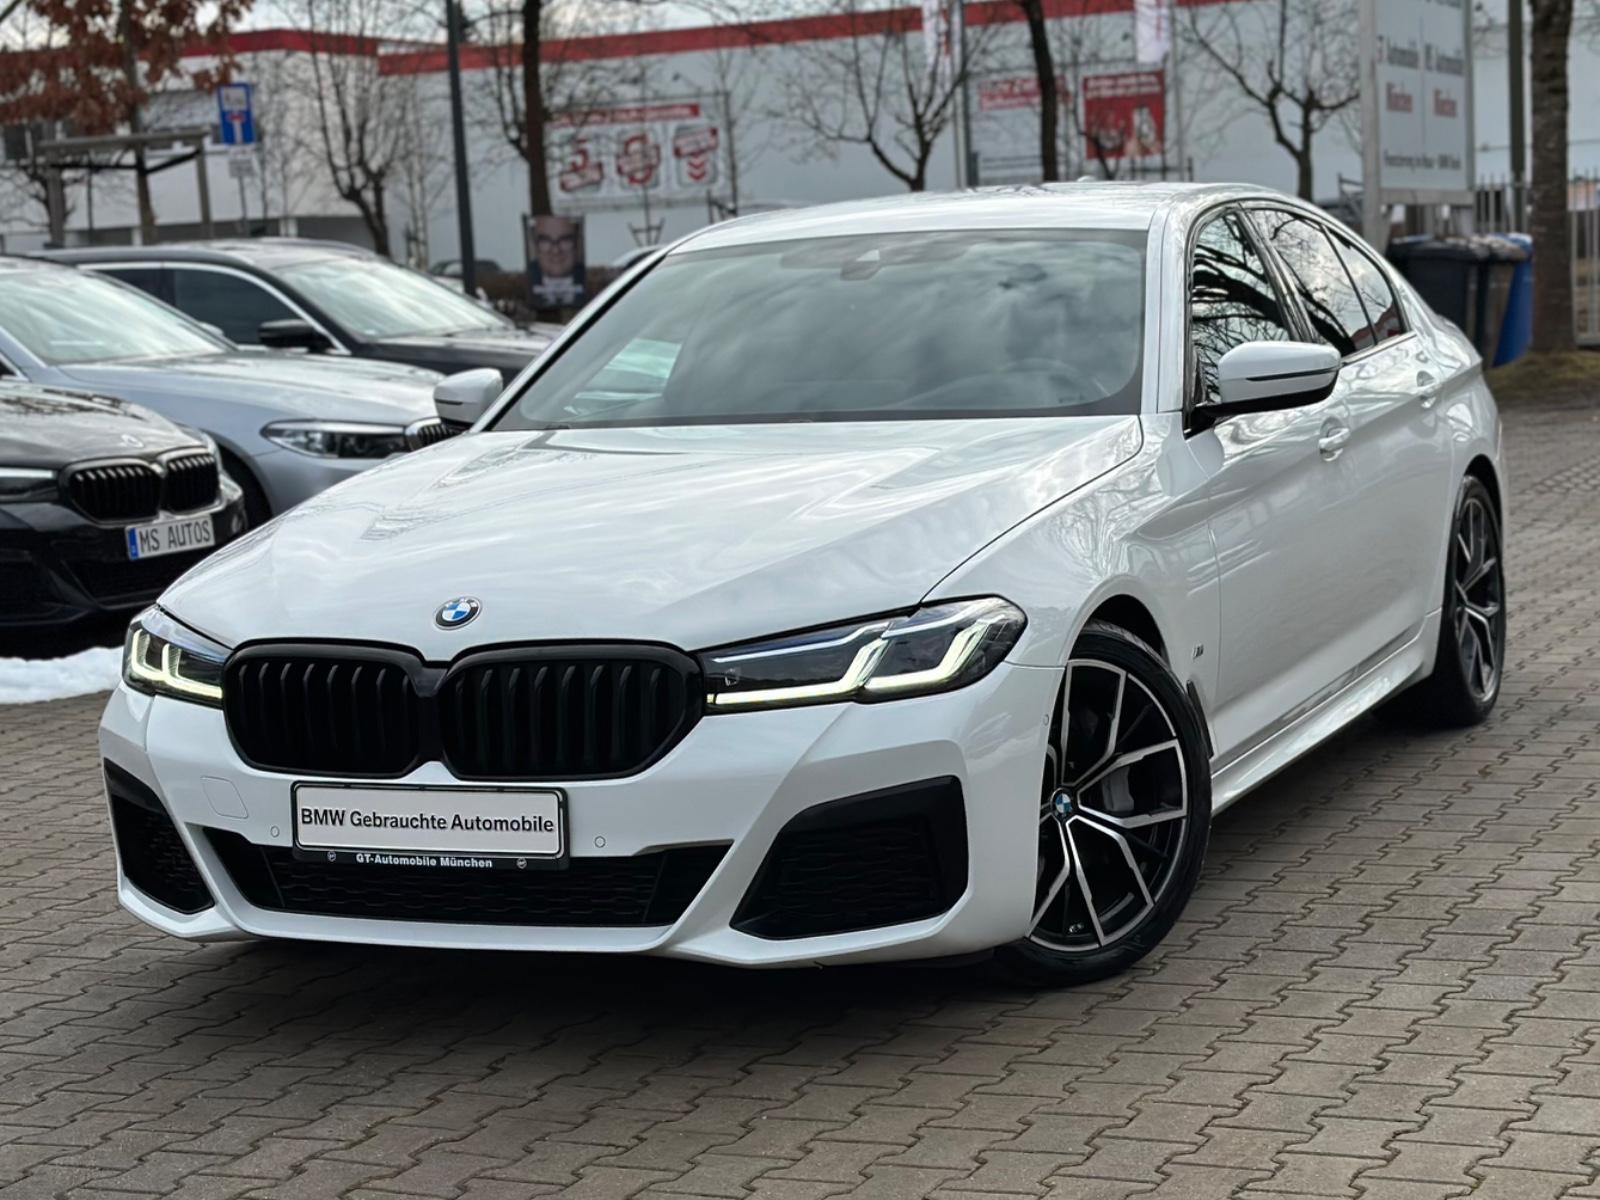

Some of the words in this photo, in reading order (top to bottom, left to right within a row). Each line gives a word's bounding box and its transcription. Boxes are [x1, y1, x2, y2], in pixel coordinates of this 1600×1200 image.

[139, 528, 160, 553] MS
[168, 520, 210, 549] AUTOS
[301, 808, 345, 826] BMW
[350, 811, 447, 830] Gebrauchte
[451, 814, 554, 832] Automobile
[356, 853, 436, 866] GT-Automobile
[440, 857, 493, 868] München
